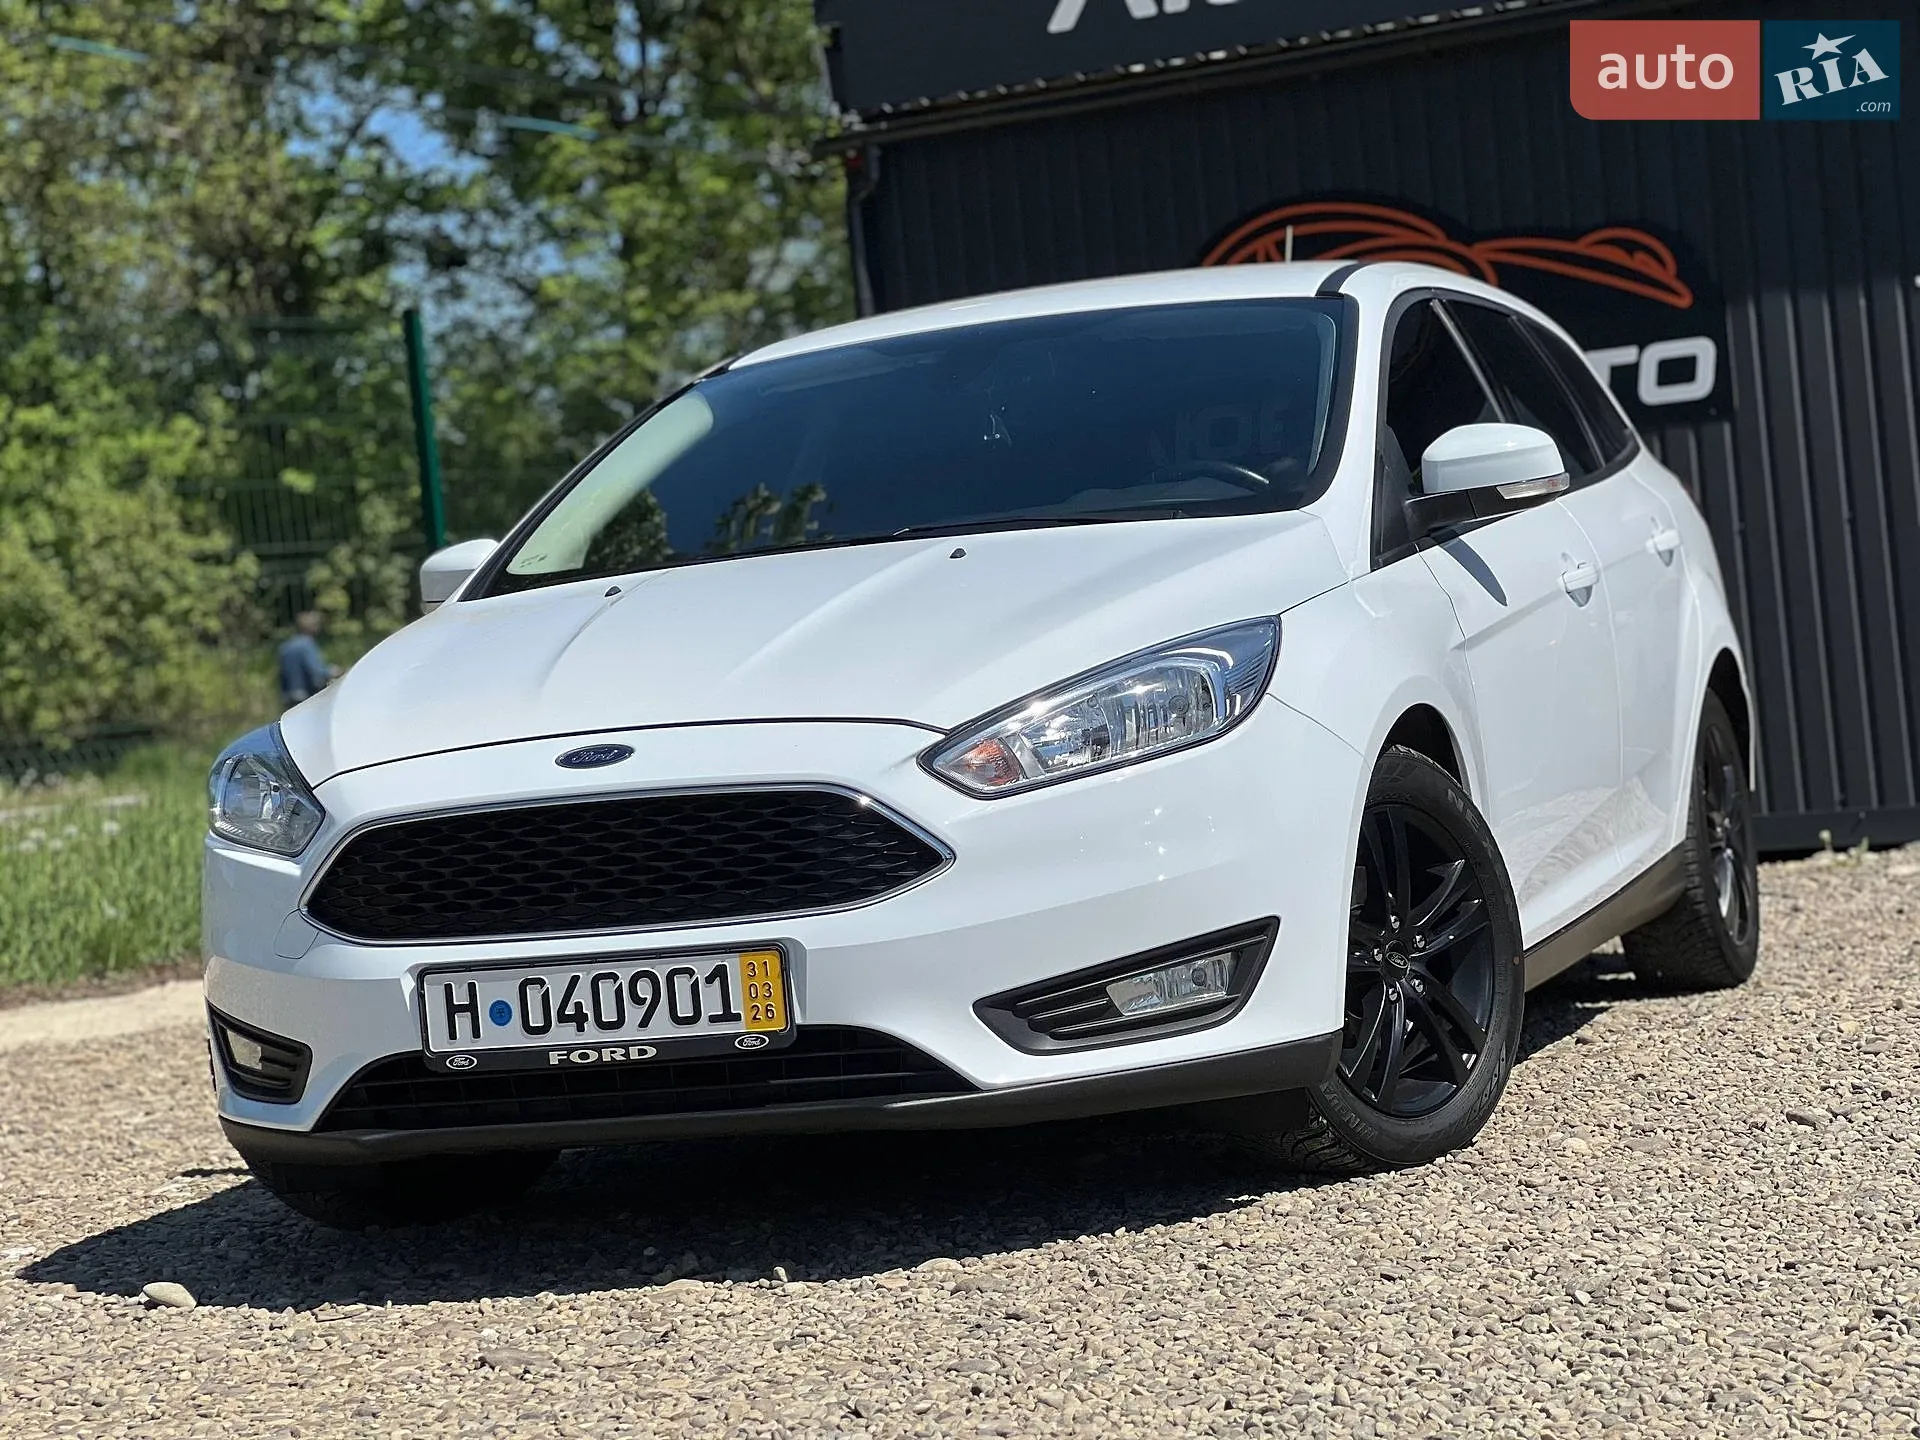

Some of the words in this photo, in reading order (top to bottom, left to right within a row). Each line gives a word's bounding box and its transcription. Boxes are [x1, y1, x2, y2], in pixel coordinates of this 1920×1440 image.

[746, 960, 770, 978] 31
[749, 981, 773, 999] 03
[443, 981, 482, 1041] H
[517, 961, 742, 1036] 040901
[751, 1002, 776, 1021] 26
[548, 1045, 658, 1065] FORD
